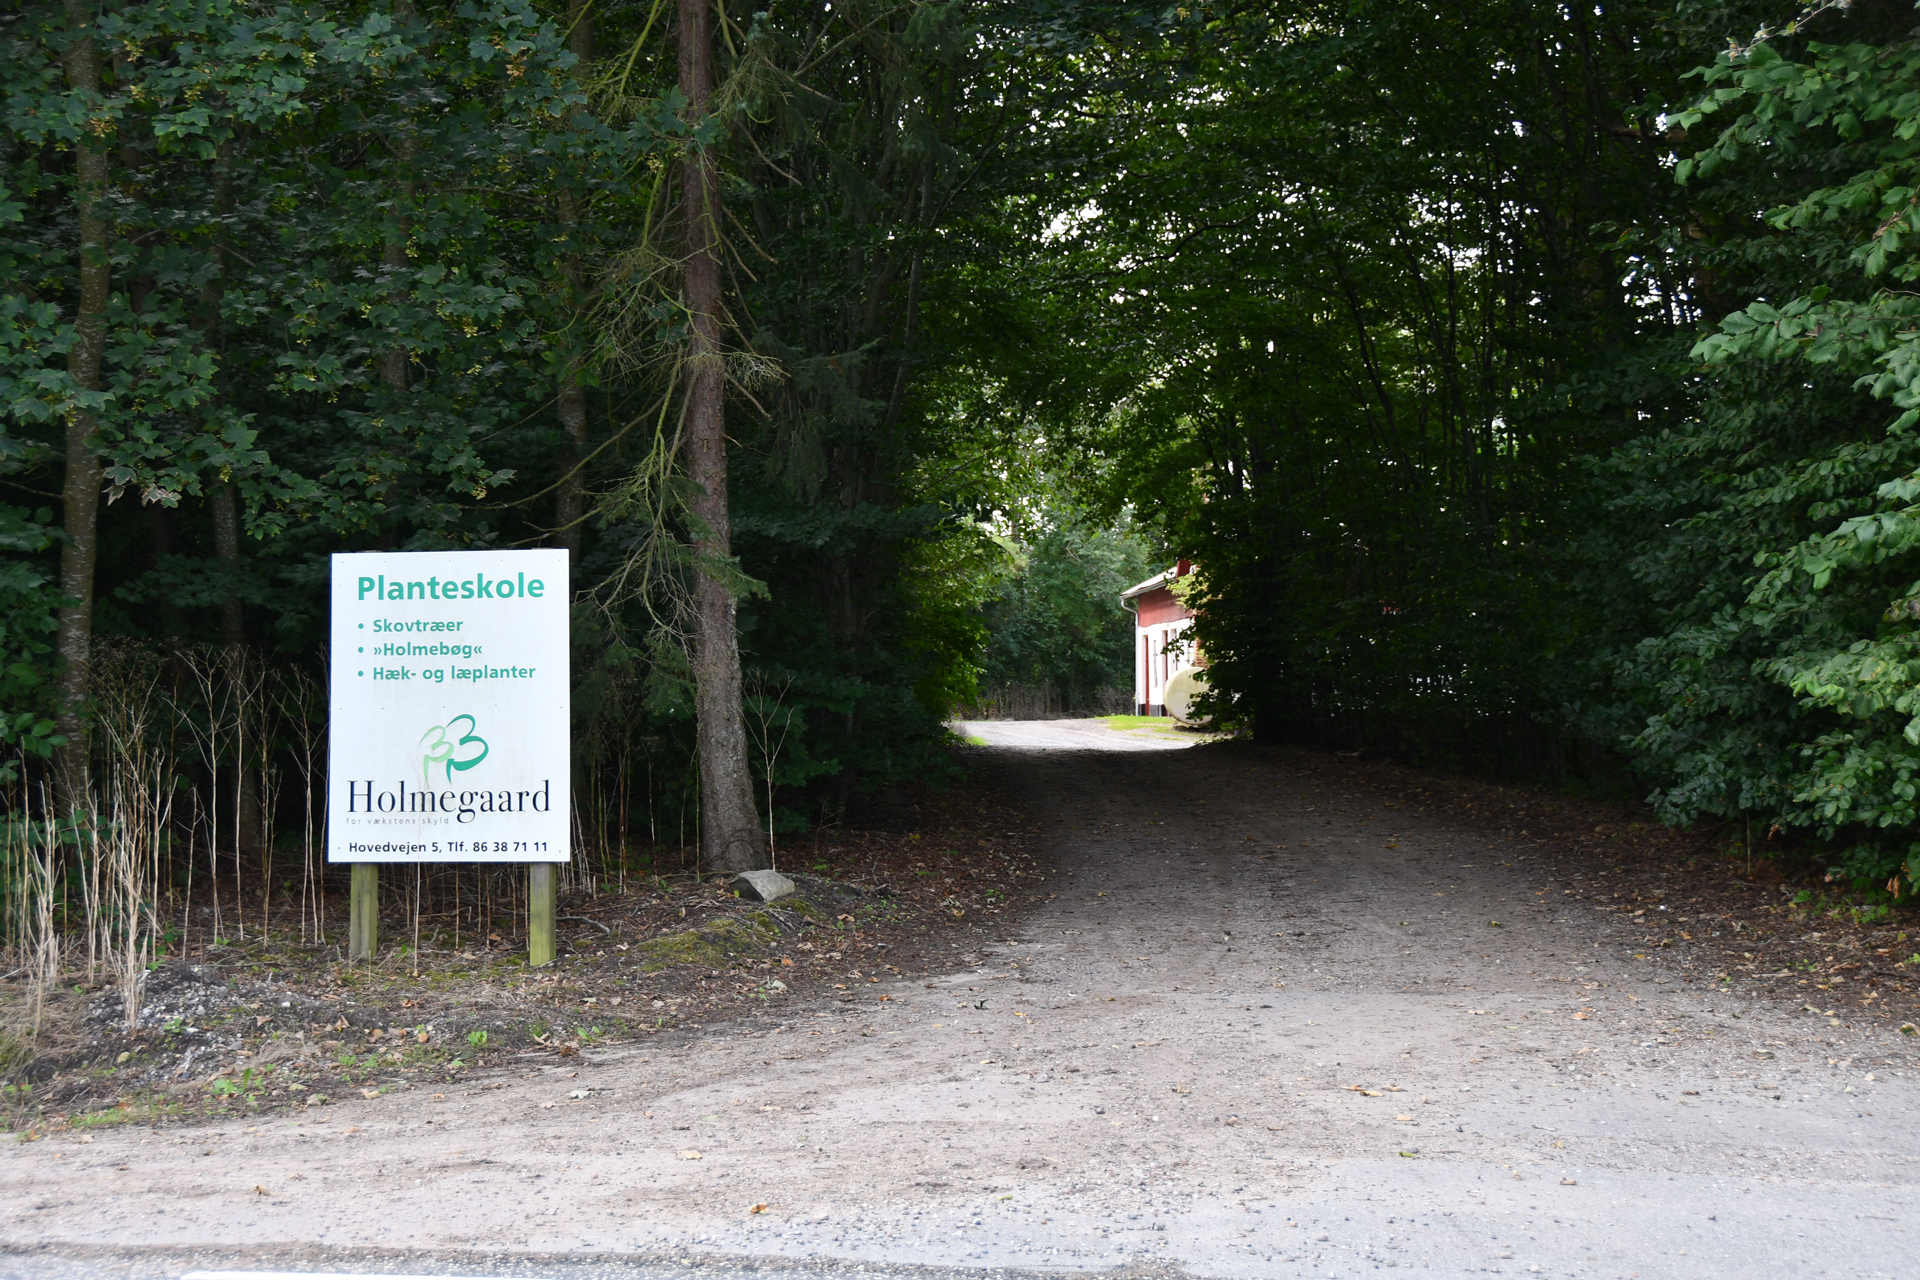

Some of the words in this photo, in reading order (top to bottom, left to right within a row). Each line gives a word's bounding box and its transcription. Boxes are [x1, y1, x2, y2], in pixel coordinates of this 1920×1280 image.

[358, 572, 545, 600] Planteskole
[373, 618, 463, 632] Skovtræer
[373, 642, 482, 658] »Holmebøg«
[373, 666, 416, 680] Hæk-
[422, 668, 444, 683] og
[451, 665, 536, 682] læplanter
[347, 779, 551, 823] Holmegaard
[367, 817, 416, 825] vækstens
[421, 817, 449, 825] skyld
[349, 842, 426, 855] Hovedvejen
[431, 842, 442, 853] 5,
[447, 841, 467, 852] Tlf.
[472, 842, 488, 852] 86
[493, 842, 508, 852] 38
[513, 842, 527, 851] 71
[534, 841, 547, 851] 11
